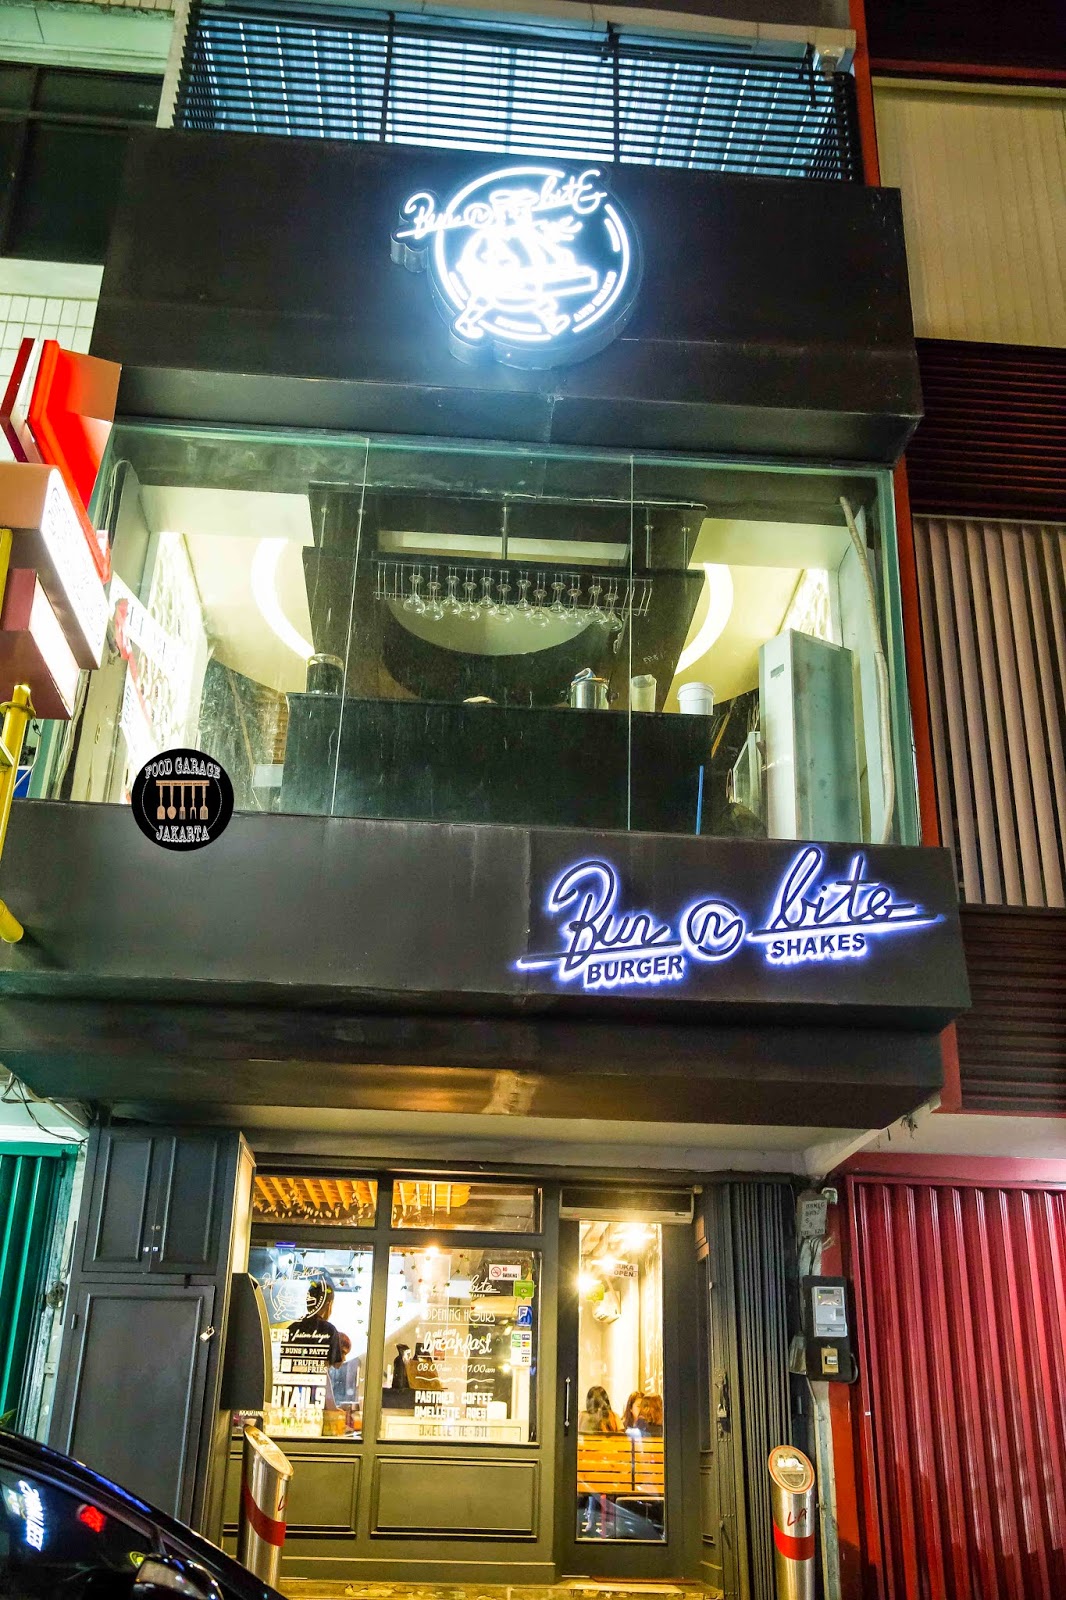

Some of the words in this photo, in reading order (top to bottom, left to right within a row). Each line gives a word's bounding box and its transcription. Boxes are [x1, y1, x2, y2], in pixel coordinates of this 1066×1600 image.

[522, 860, 682, 972] Bun
[754, 846, 938, 937] bite
[772, 933, 866, 959] SHAKES
[587, 955, 684, 986] BURGER
[424, 1308, 461, 1321] OPENING
[464, 1309, 496, 1323] HOURS
[285, 1347, 302, 1355] BUNS
[309, 1348, 329, 1356] PATTY
[421, 1331, 492, 1359] breakfast
[292, 1359, 325, 1367] TRUFFLE
[461, 1392, 493, 1405] COFFEE
